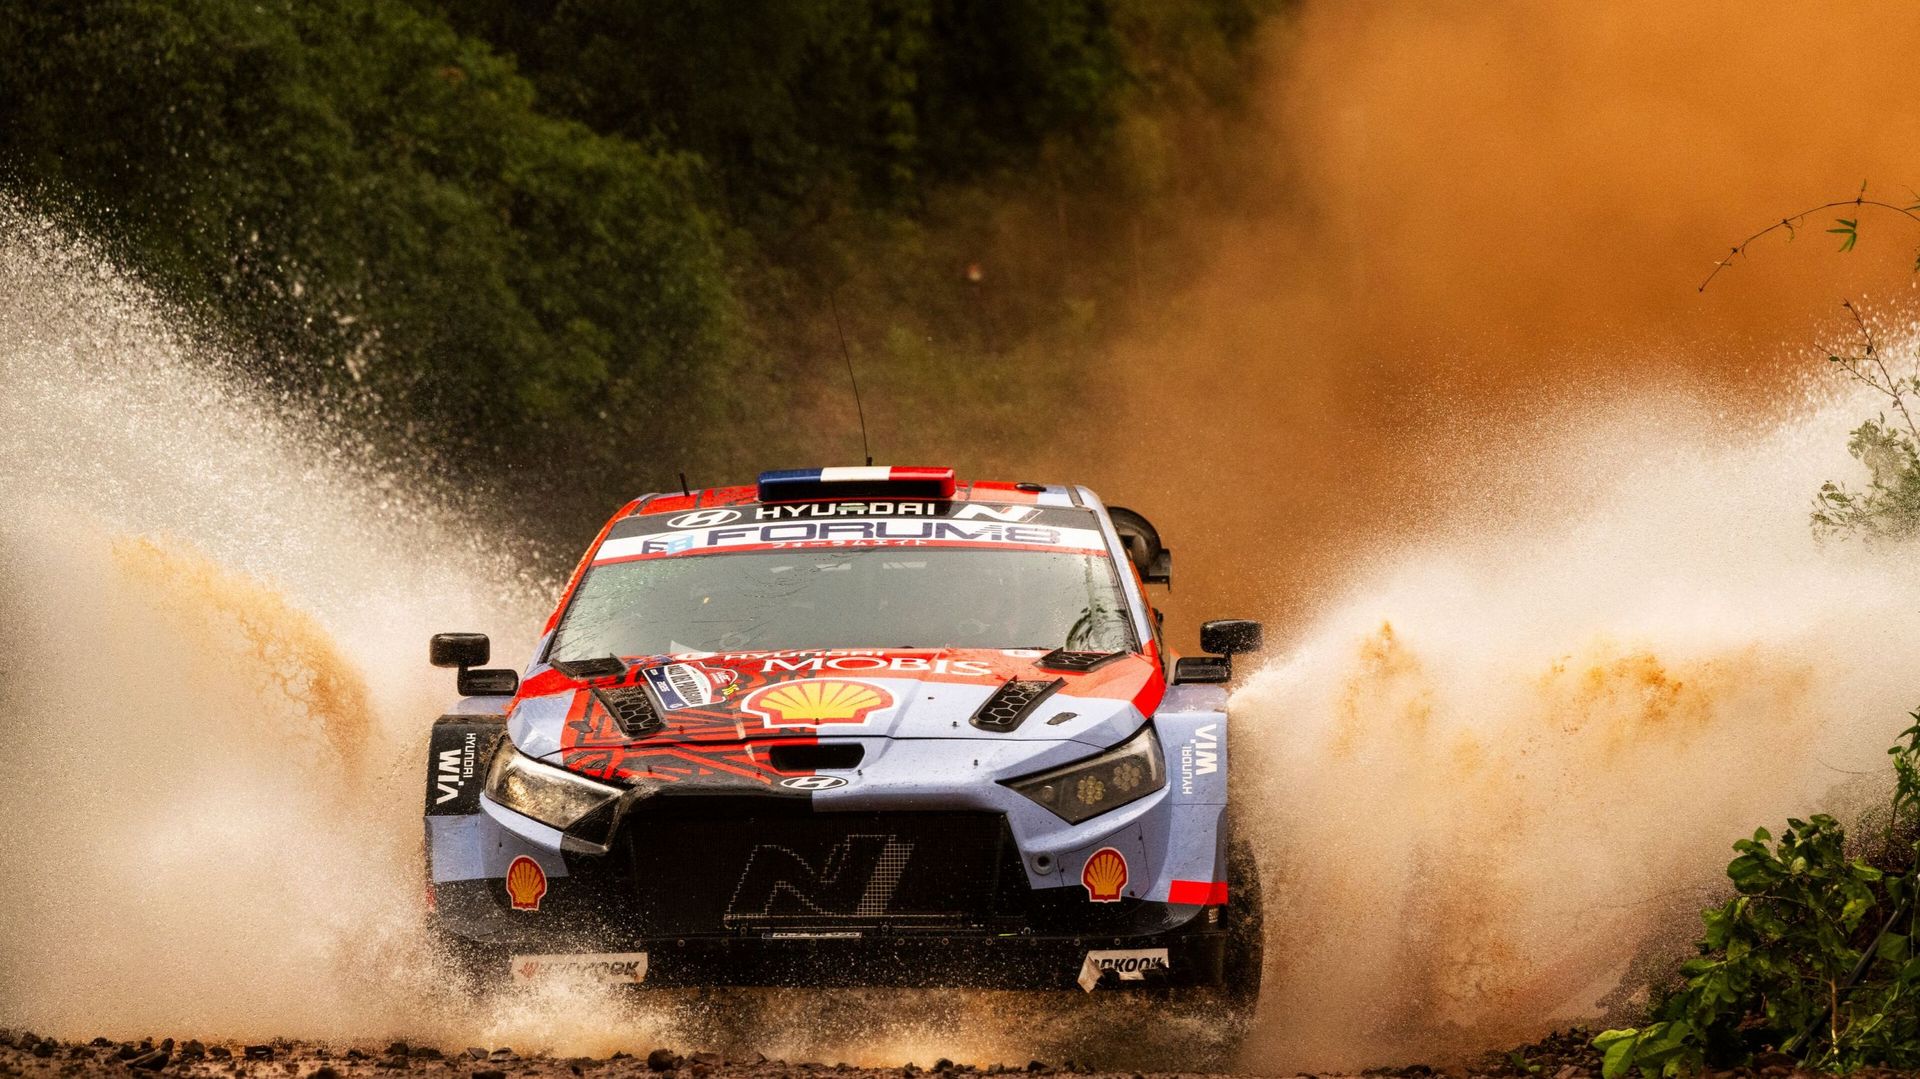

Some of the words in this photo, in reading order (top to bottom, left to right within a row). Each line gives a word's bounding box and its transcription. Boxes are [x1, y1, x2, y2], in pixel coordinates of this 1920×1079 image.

[755, 502, 936, 519] HYUNDAI
[707, 521, 1061, 546] FORUM8
[772, 539, 927, 549] フォーラムエイト
[761, 657, 992, 676] MOBIS
[463, 733, 476, 777] HYUNDAI
[1182, 746, 1192, 794] HYUNDAI
